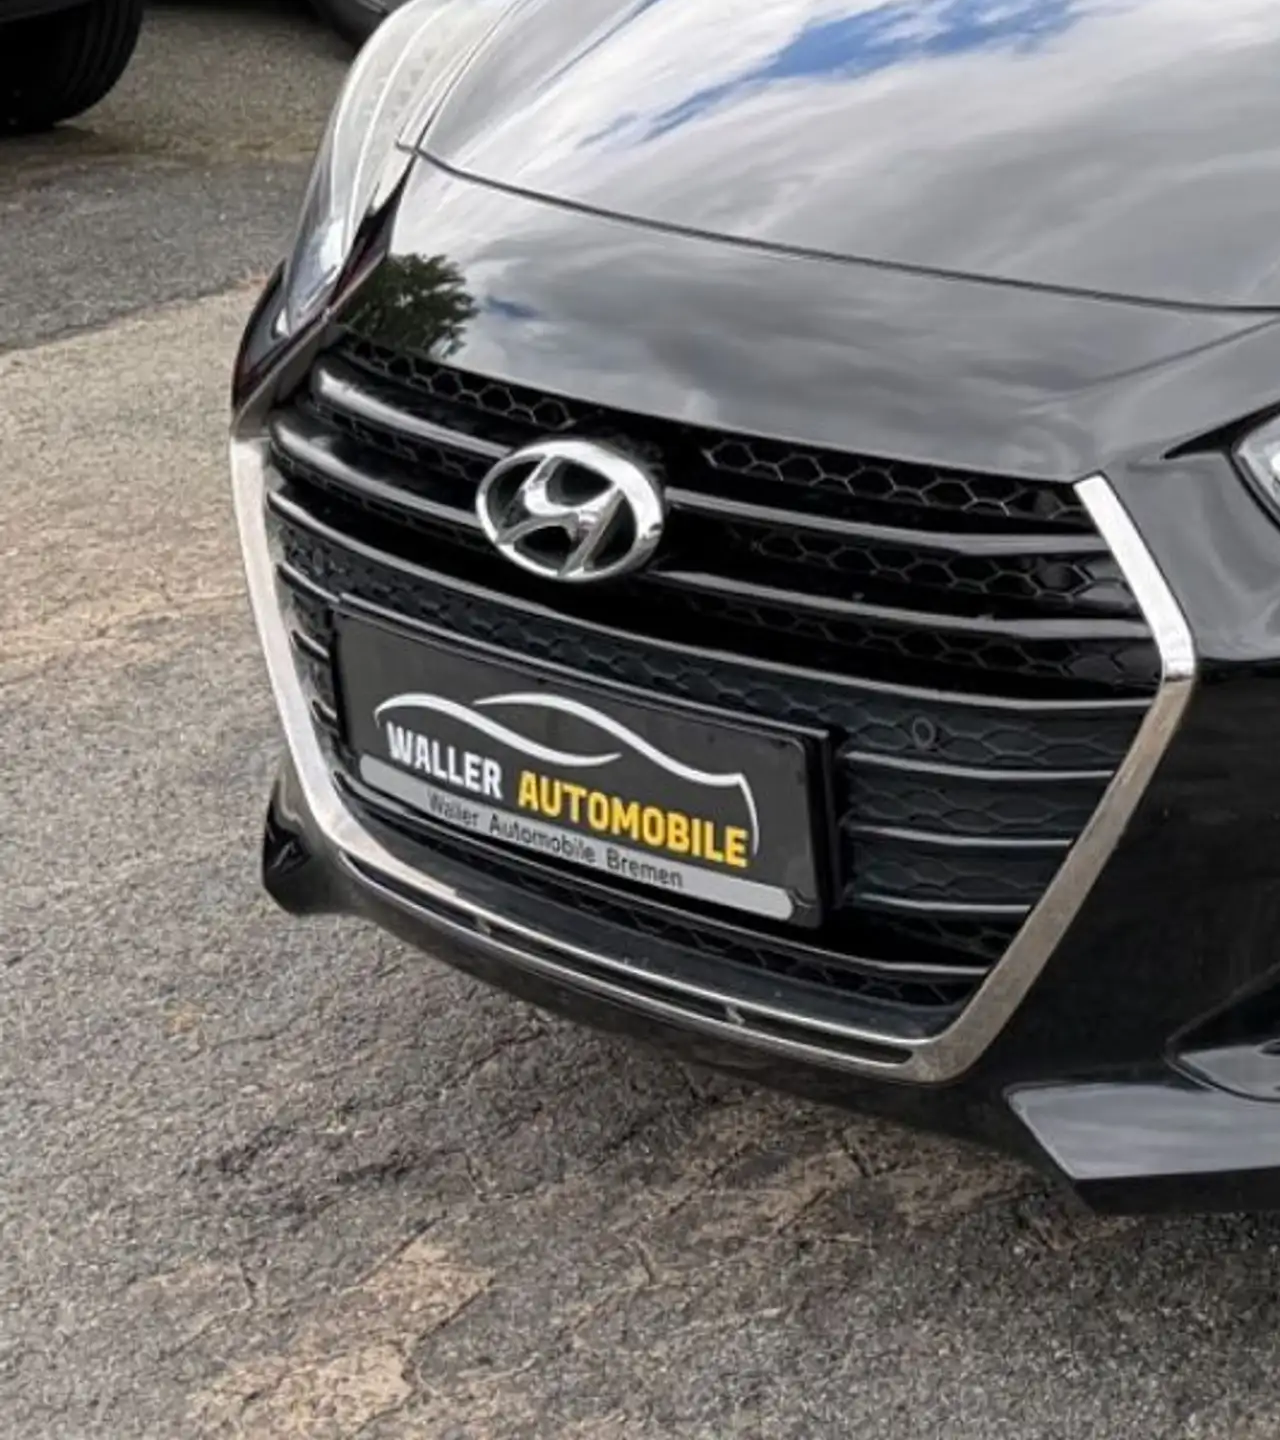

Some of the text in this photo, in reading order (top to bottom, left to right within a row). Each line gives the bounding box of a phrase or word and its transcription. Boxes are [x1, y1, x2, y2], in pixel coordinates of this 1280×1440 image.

[386, 720, 748, 869] WALLER AUTOMOBILE
[427, 790, 684, 889] Waller Automobile Bremen
